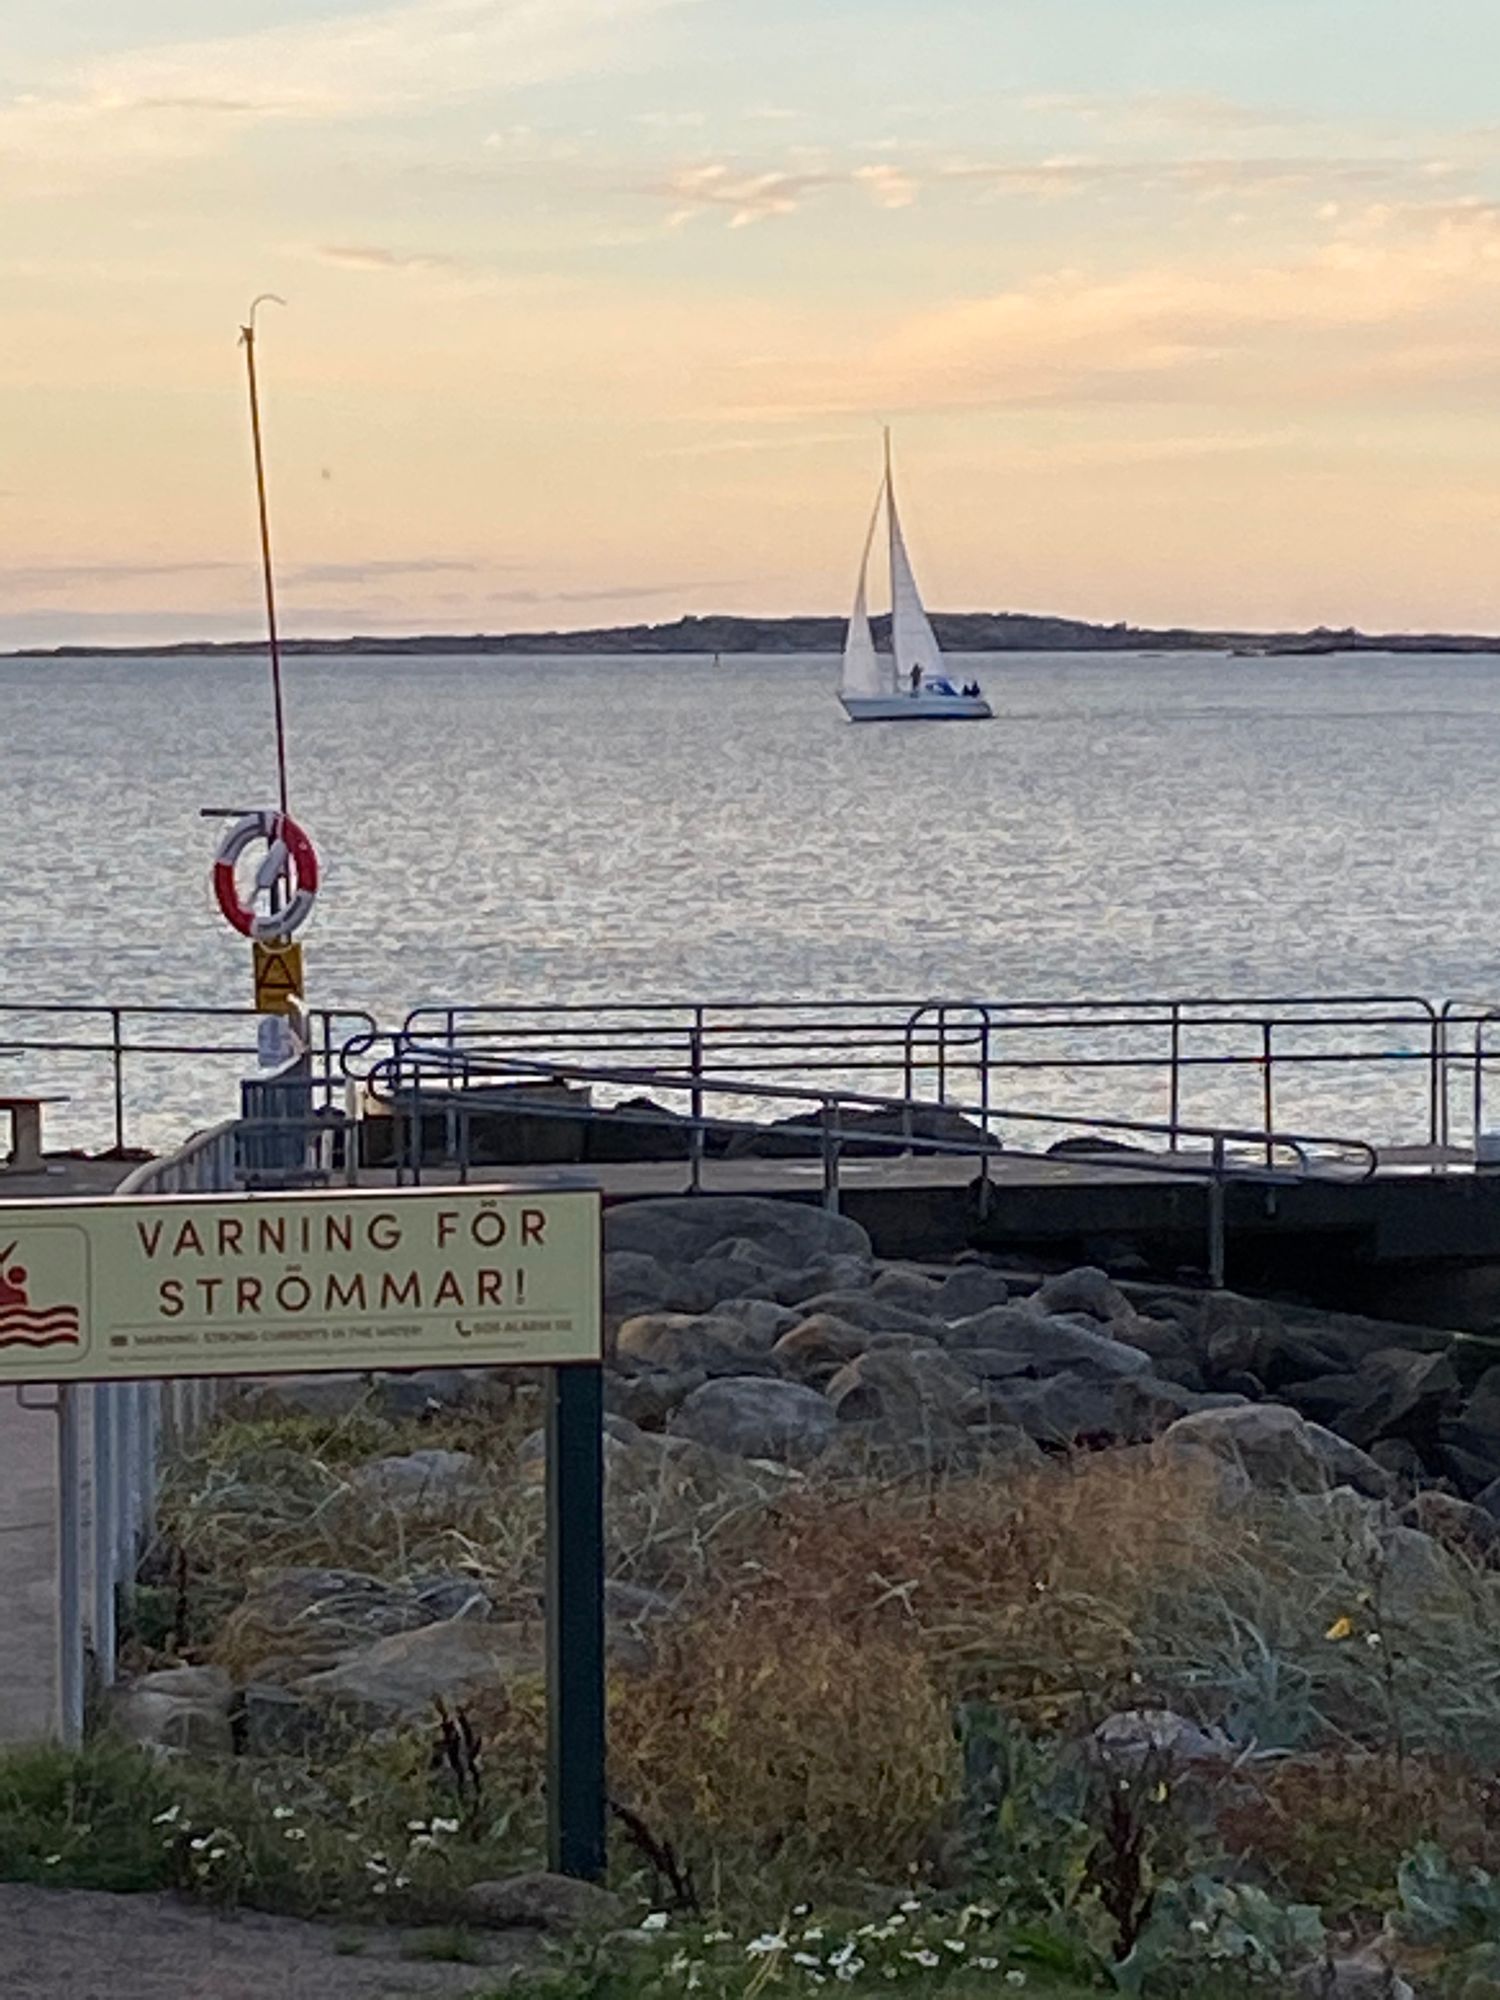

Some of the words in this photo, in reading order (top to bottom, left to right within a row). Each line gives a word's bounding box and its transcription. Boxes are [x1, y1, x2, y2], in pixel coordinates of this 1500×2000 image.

[136, 1214, 404, 1258] VARNING
[436, 1199, 548, 1249] FÖR
[158, 1265, 527, 1317] STRÖMMAR!
